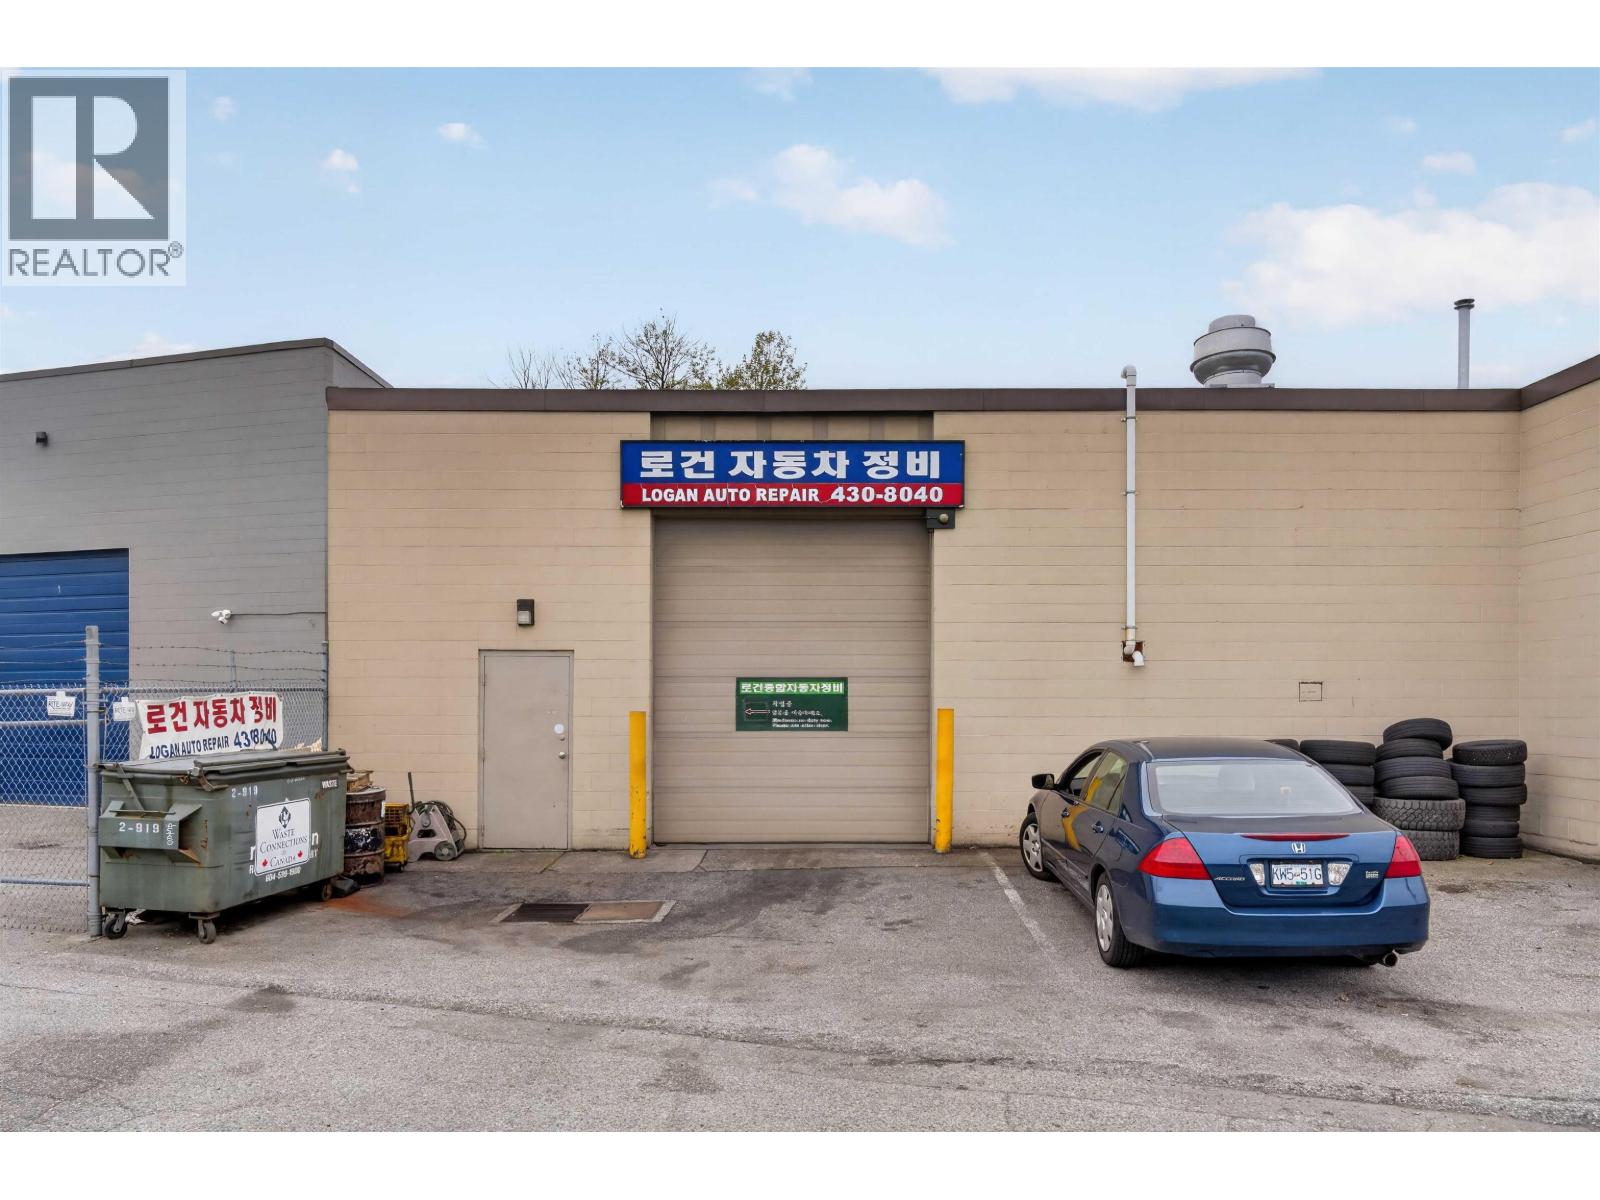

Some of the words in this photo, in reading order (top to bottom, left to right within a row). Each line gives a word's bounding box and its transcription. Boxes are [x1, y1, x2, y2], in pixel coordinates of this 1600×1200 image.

[640, 450, 715, 479] 로건
[728, 450, 850, 480] 자동차
[862, 450, 940, 480] 정비
[641, 488, 698, 502] LOGAN
[703, 488, 751, 502] AUTO
[755, 488, 820, 502] REPAIR
[830, 486, 944, 503] 430-8040
[146, 700, 188, 734] 로건
[193, 697, 246, 730] 자동차
[248, 696, 277, 723] 정비
[150, 744, 181, 759] LOGAN
[181, 739, 201, 755] AUTO
[203, 735, 230, 752] REPAIR
[231, 785, 258, 798] 2-919
[119, 822, 160, 833] 2-919
